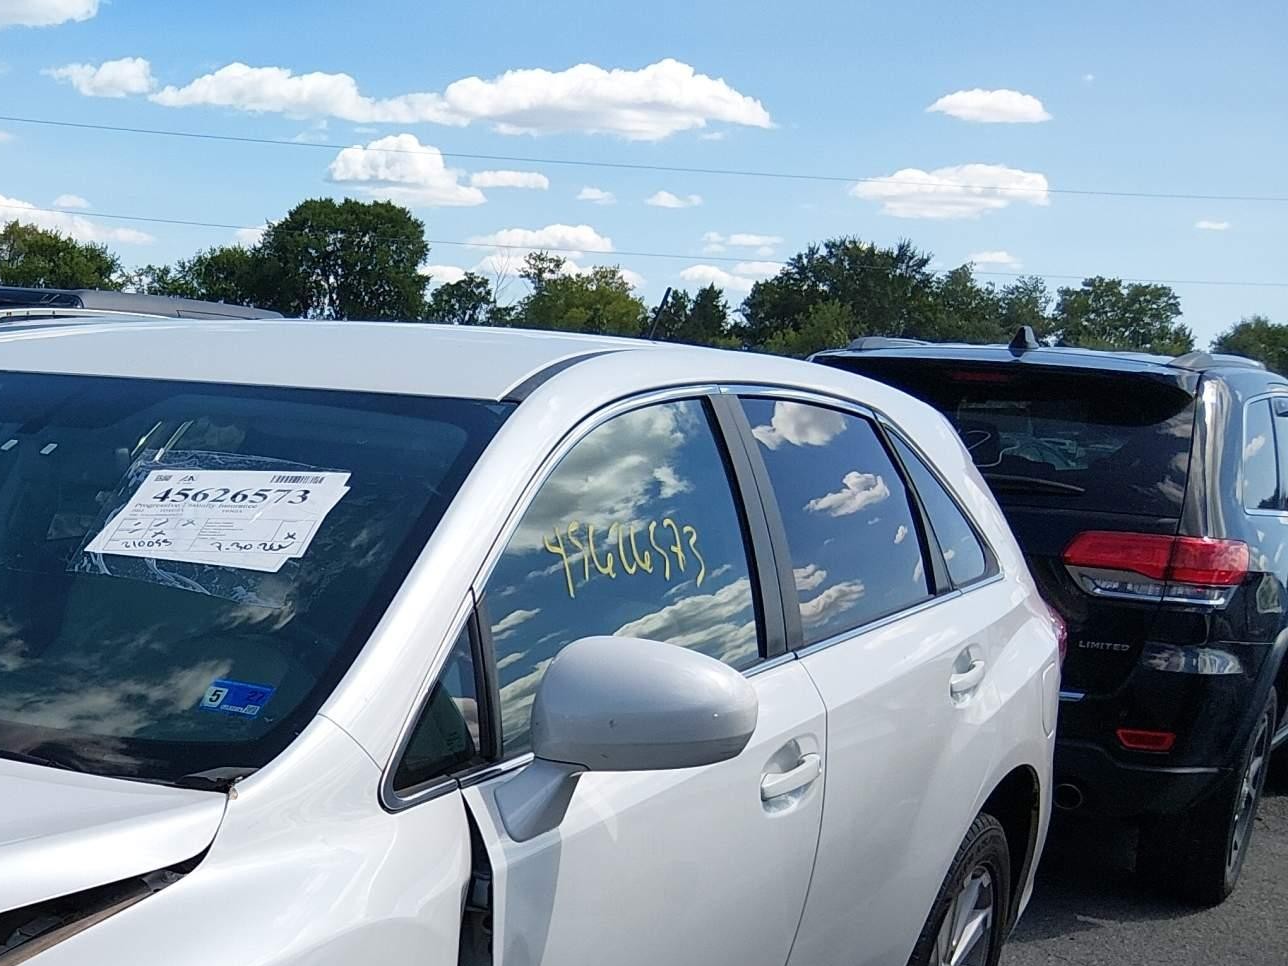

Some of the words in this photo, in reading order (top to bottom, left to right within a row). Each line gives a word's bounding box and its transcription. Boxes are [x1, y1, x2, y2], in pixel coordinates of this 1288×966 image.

[152, 487, 311, 505] 45626573
[1078, 640, 1130, 651] LIMITED
[208, 689, 223, 703] 5
